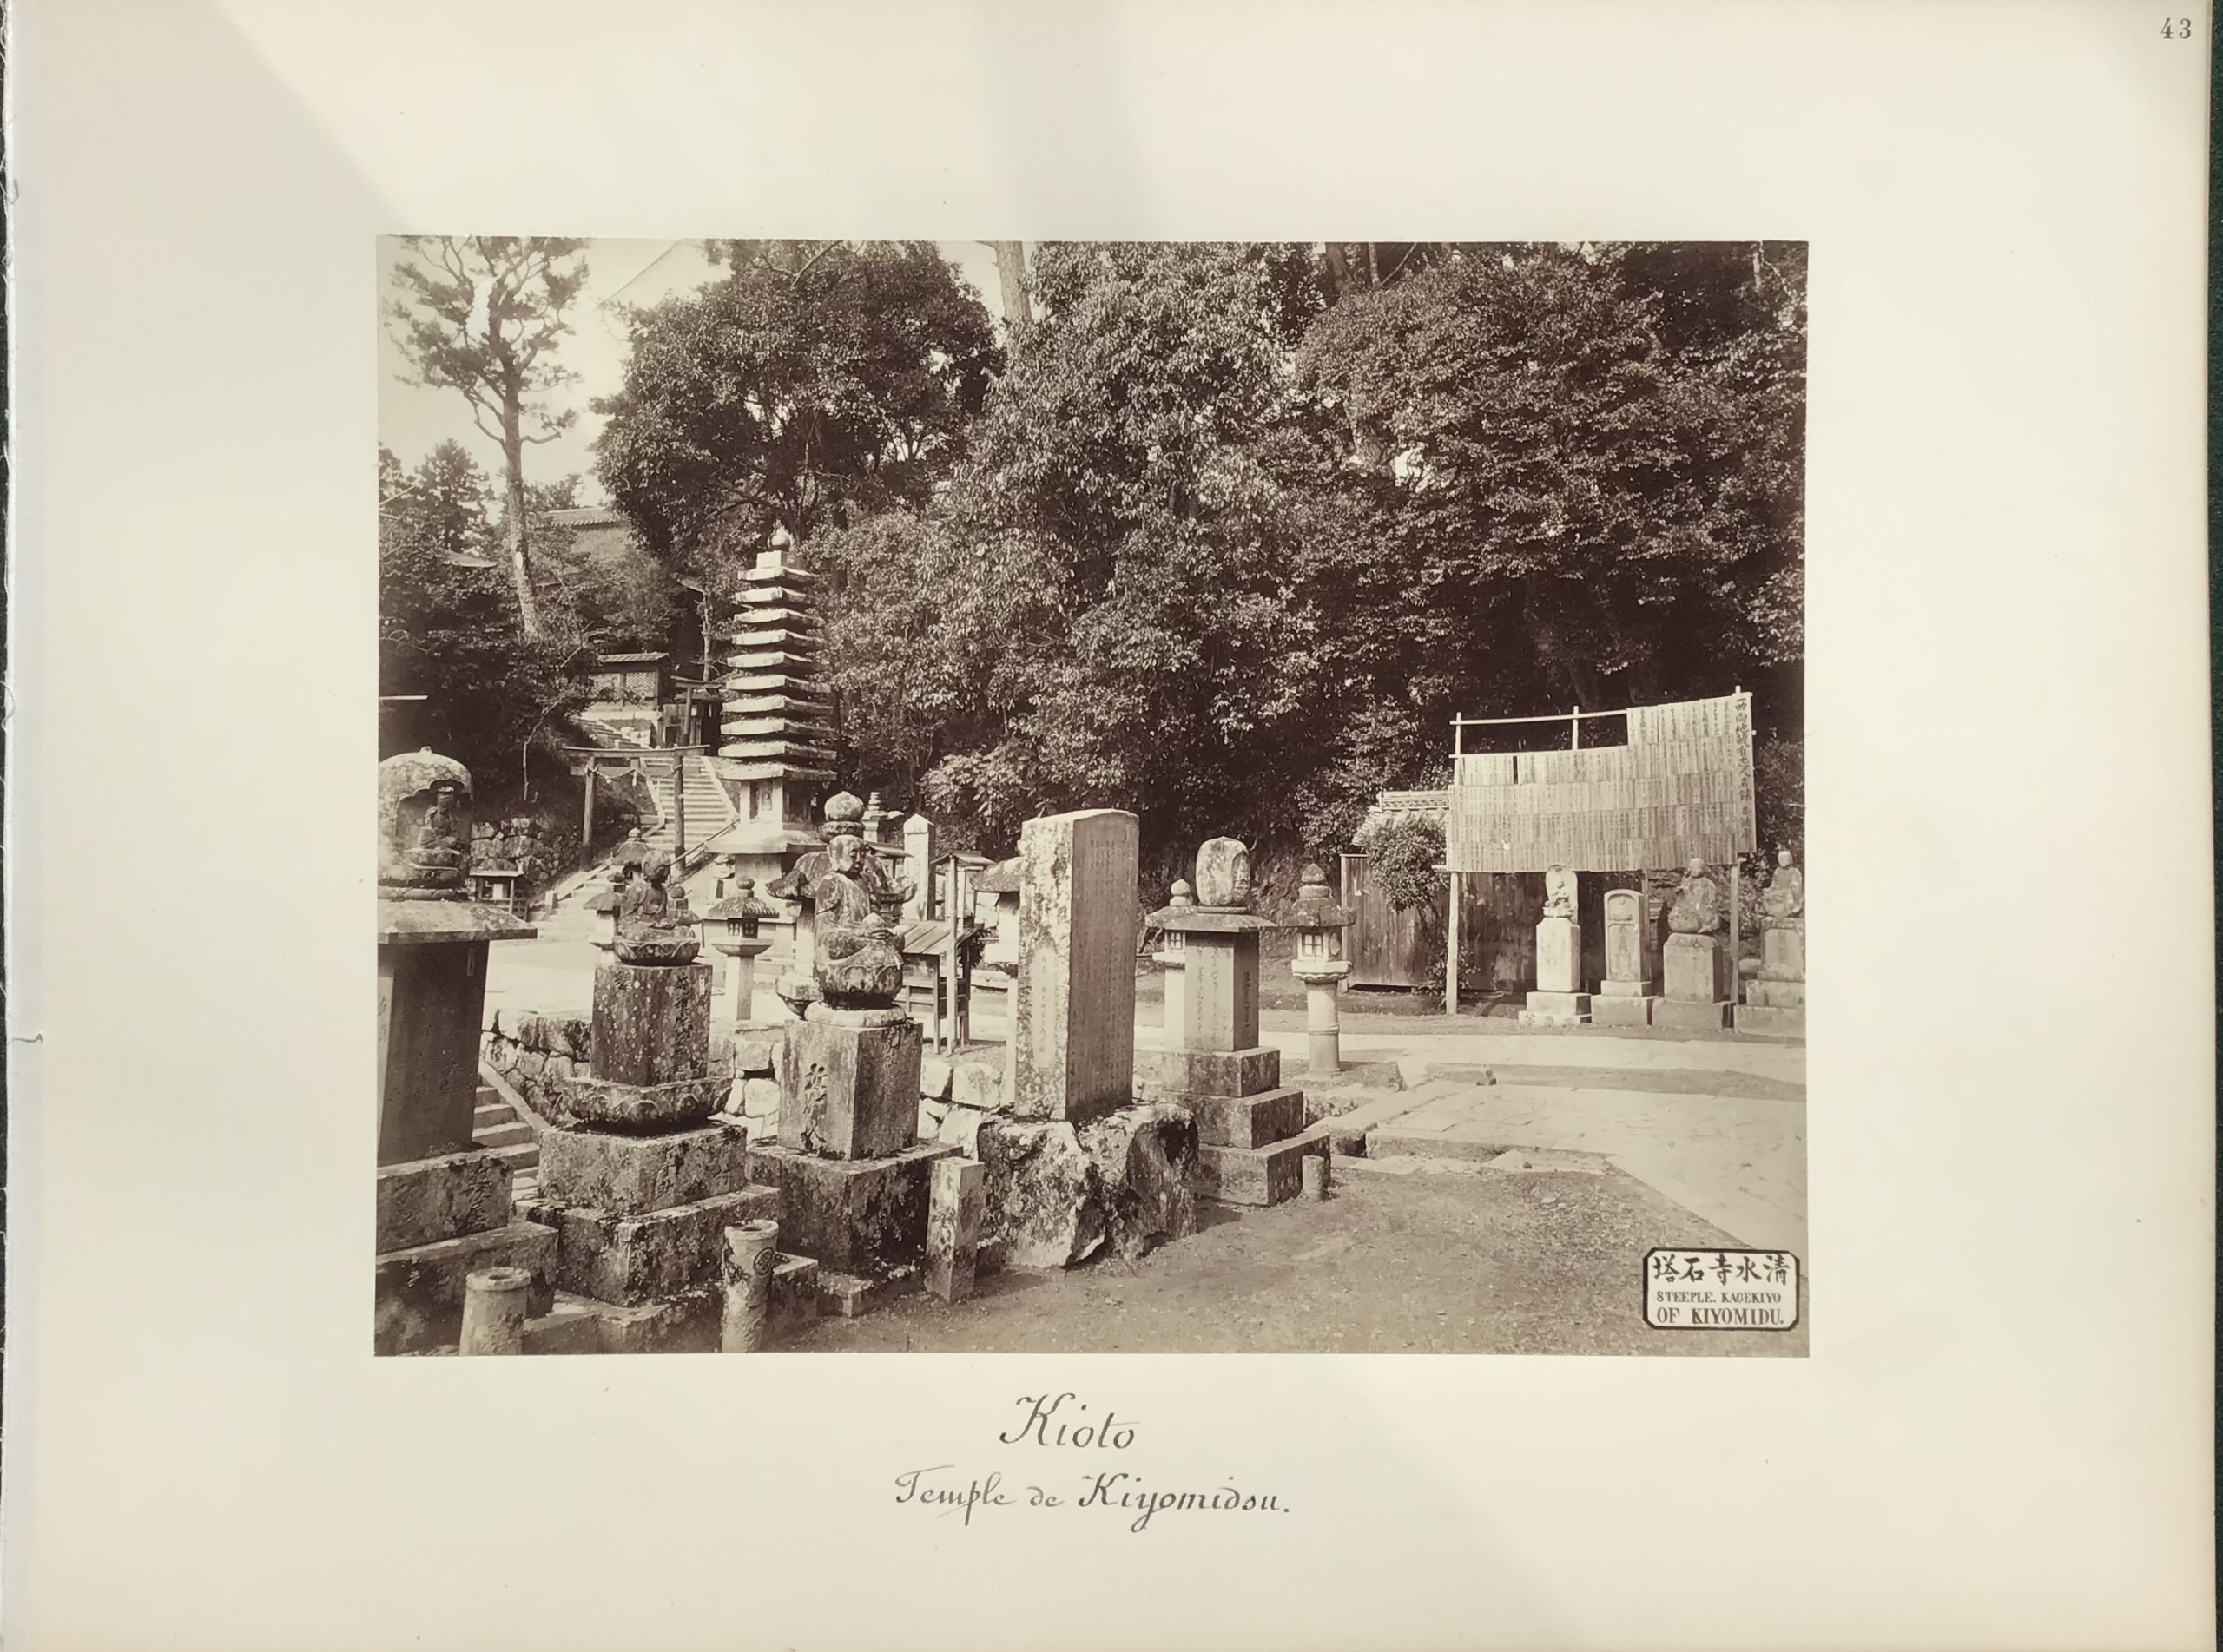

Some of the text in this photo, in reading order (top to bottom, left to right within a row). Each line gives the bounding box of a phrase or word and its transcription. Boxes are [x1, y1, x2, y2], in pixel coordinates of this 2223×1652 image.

[2160, 17, 2193, 40] 43
[999, 1392, 1140, 1449] Kioto
[895, 1464, 1017, 1526] Temple
[1026, 1485, 1065, 1507] de
